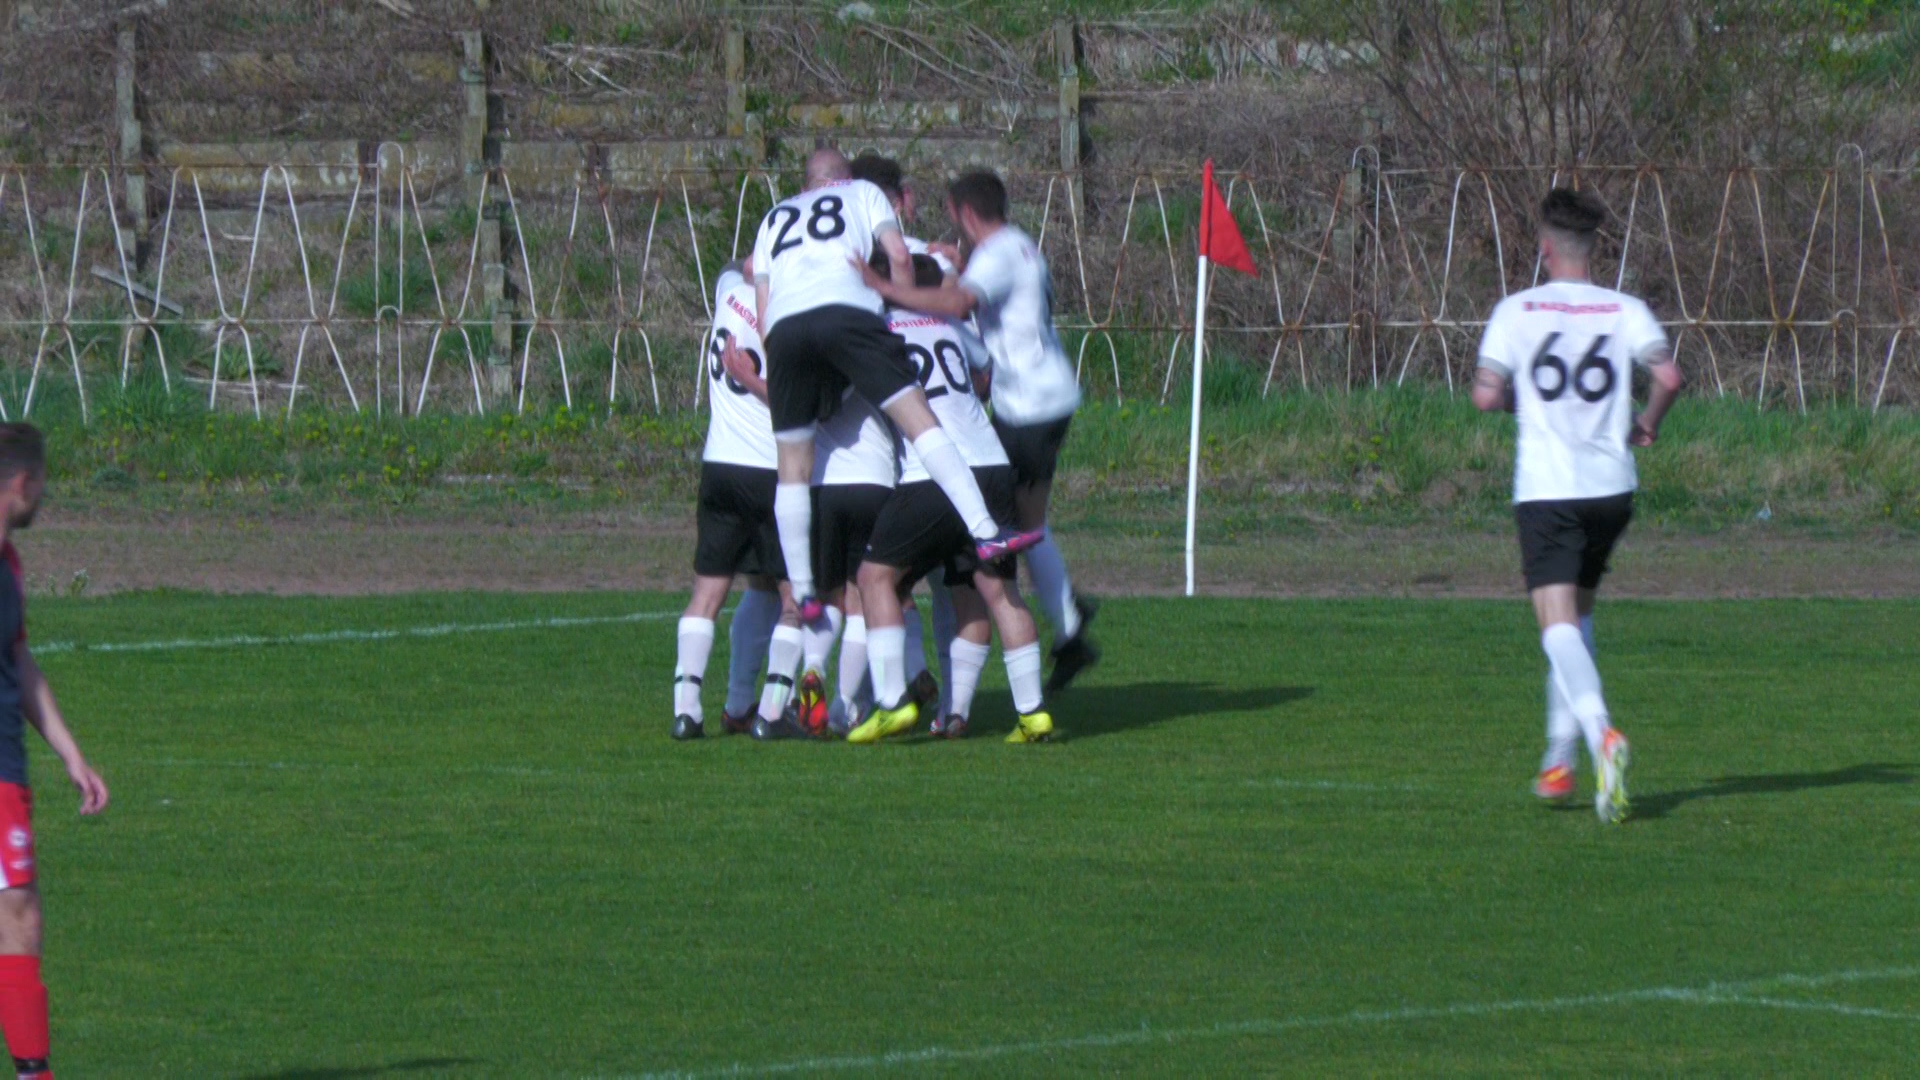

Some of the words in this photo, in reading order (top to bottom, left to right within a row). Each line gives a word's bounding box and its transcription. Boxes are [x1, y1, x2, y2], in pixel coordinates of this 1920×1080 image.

[768, 195, 846, 261] 28
[904, 338, 970, 401] 20
[1531, 331, 1615, 402] 66
